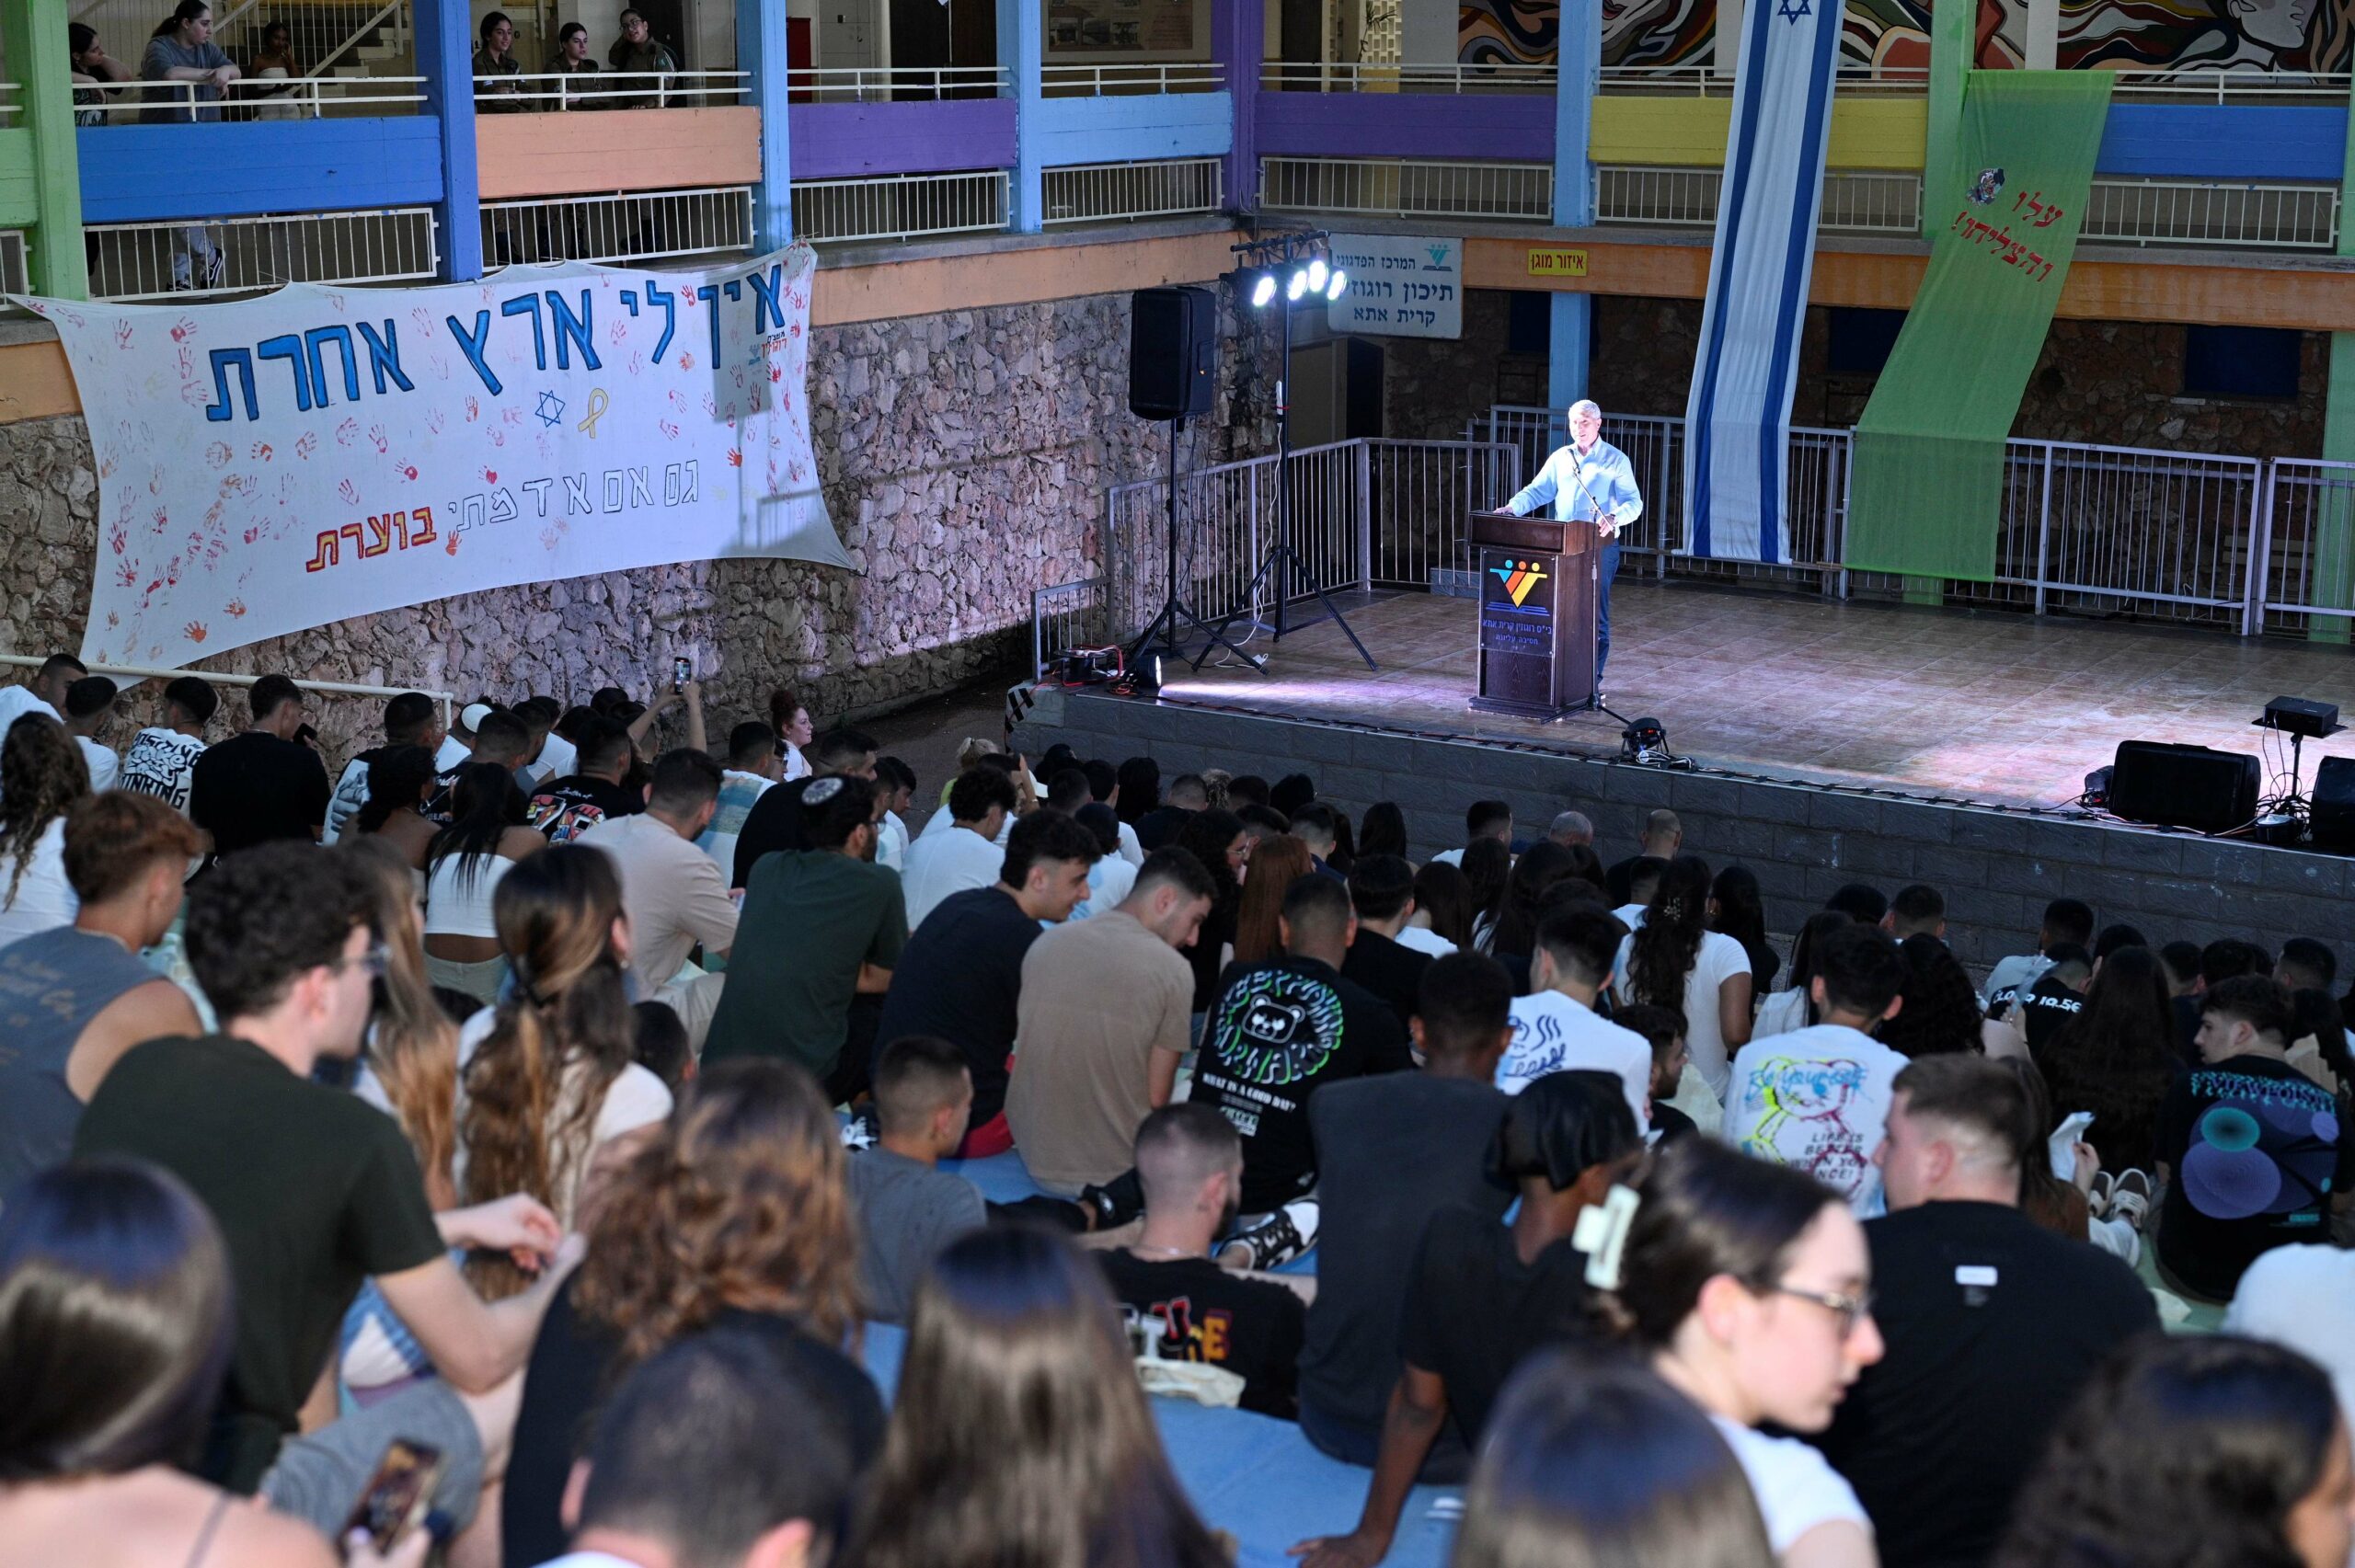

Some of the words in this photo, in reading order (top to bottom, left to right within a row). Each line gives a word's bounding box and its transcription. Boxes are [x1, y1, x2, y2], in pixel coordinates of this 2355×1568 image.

[2012, 191, 2063, 227] עלו
[1951, 211, 2054, 282] והצליחו!
[1336, 254, 1375, 268] הפדגוגי
[1381, 257, 1416, 270] המרכז
[1532, 254, 1553, 270] מוגן
[1557, 255, 1583, 269] איזור
[1347, 279, 1393, 299] רוגוז
[1403, 281, 1453, 304] תיכון
[620, 280, 675, 365] לי
[697, 264, 786, 370] אין
[1353, 306, 1387, 321] אתא
[1396, 308, 1435, 327] קרית
[445, 288, 603, 397] ארץ
[205, 317, 415, 422] אחרת
[603, 465, 654, 514] אם
[663, 459, 699, 508] גם
[305, 506, 437, 573] בוערת
[1482, 619, 1497, 628] אתא
[1499, 621, 1514, 632] קרית
